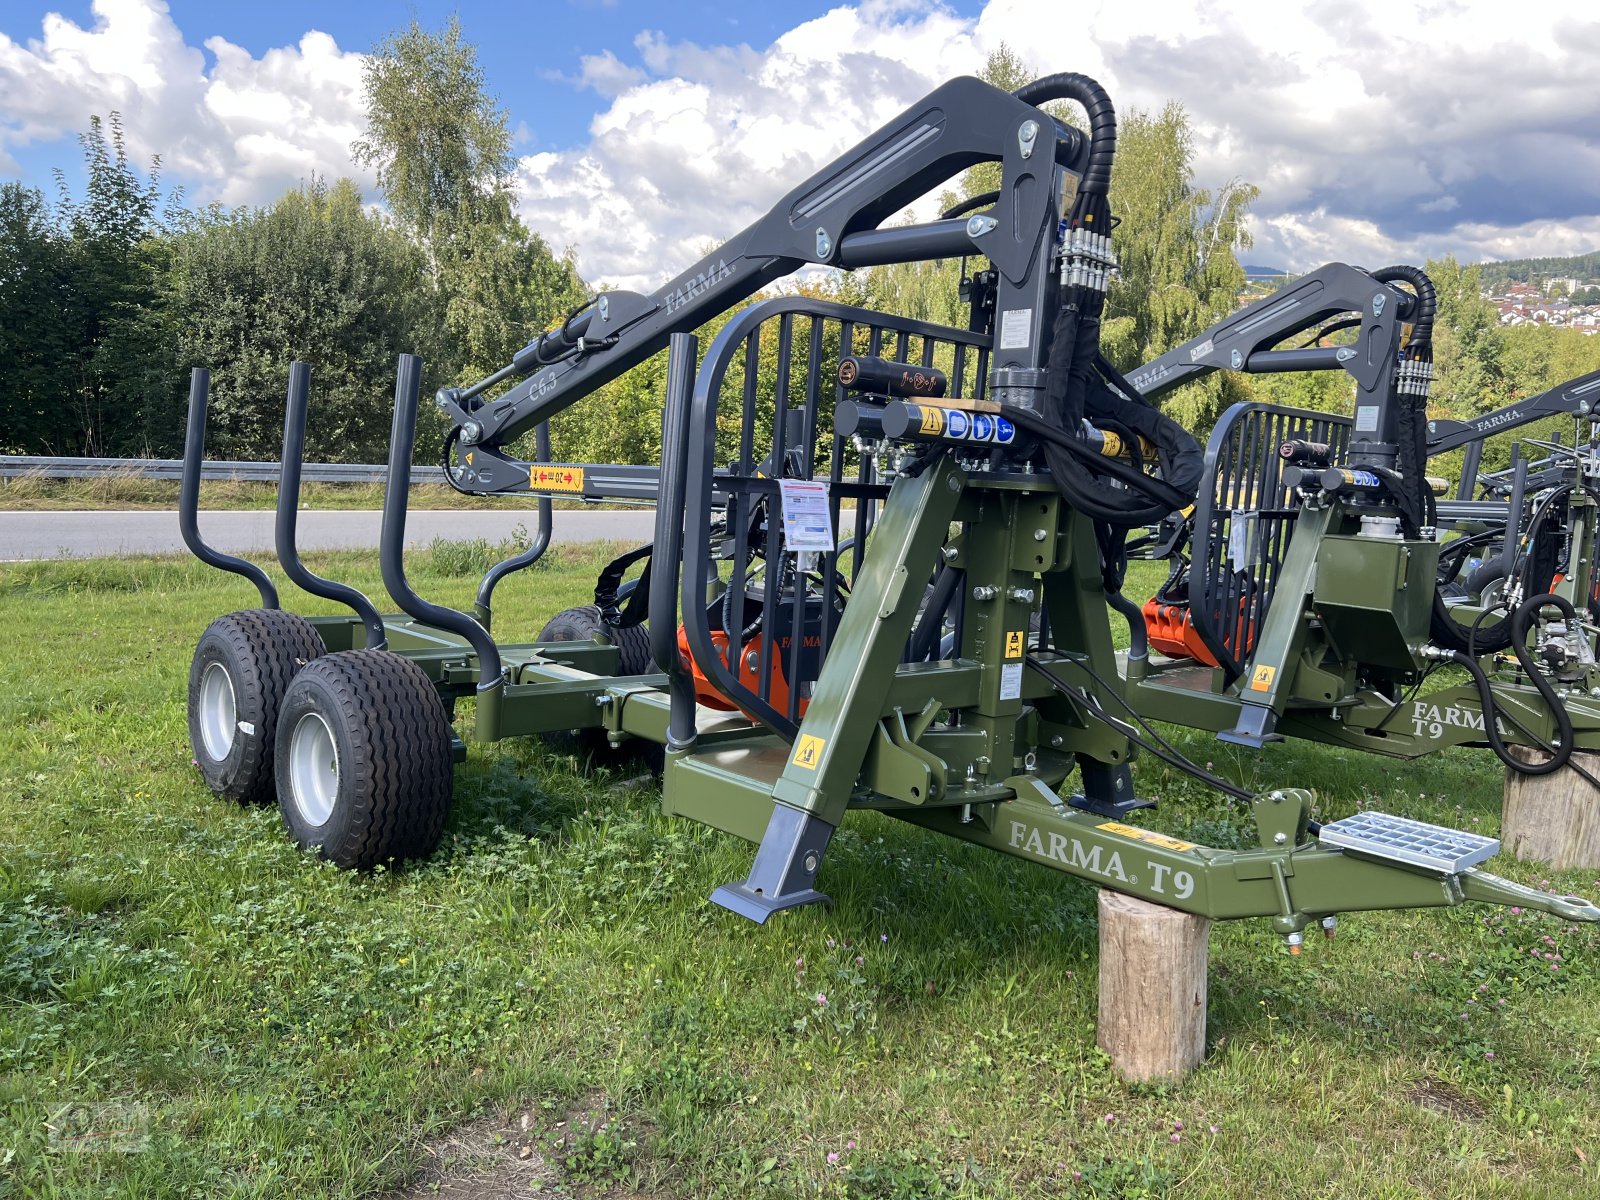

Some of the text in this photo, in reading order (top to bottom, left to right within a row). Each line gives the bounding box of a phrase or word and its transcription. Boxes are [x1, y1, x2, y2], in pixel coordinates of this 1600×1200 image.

[529, 371, 557, 401] C6.3
[1412, 718, 1443, 739] T9
[1147, 860, 1195, 900] T9
